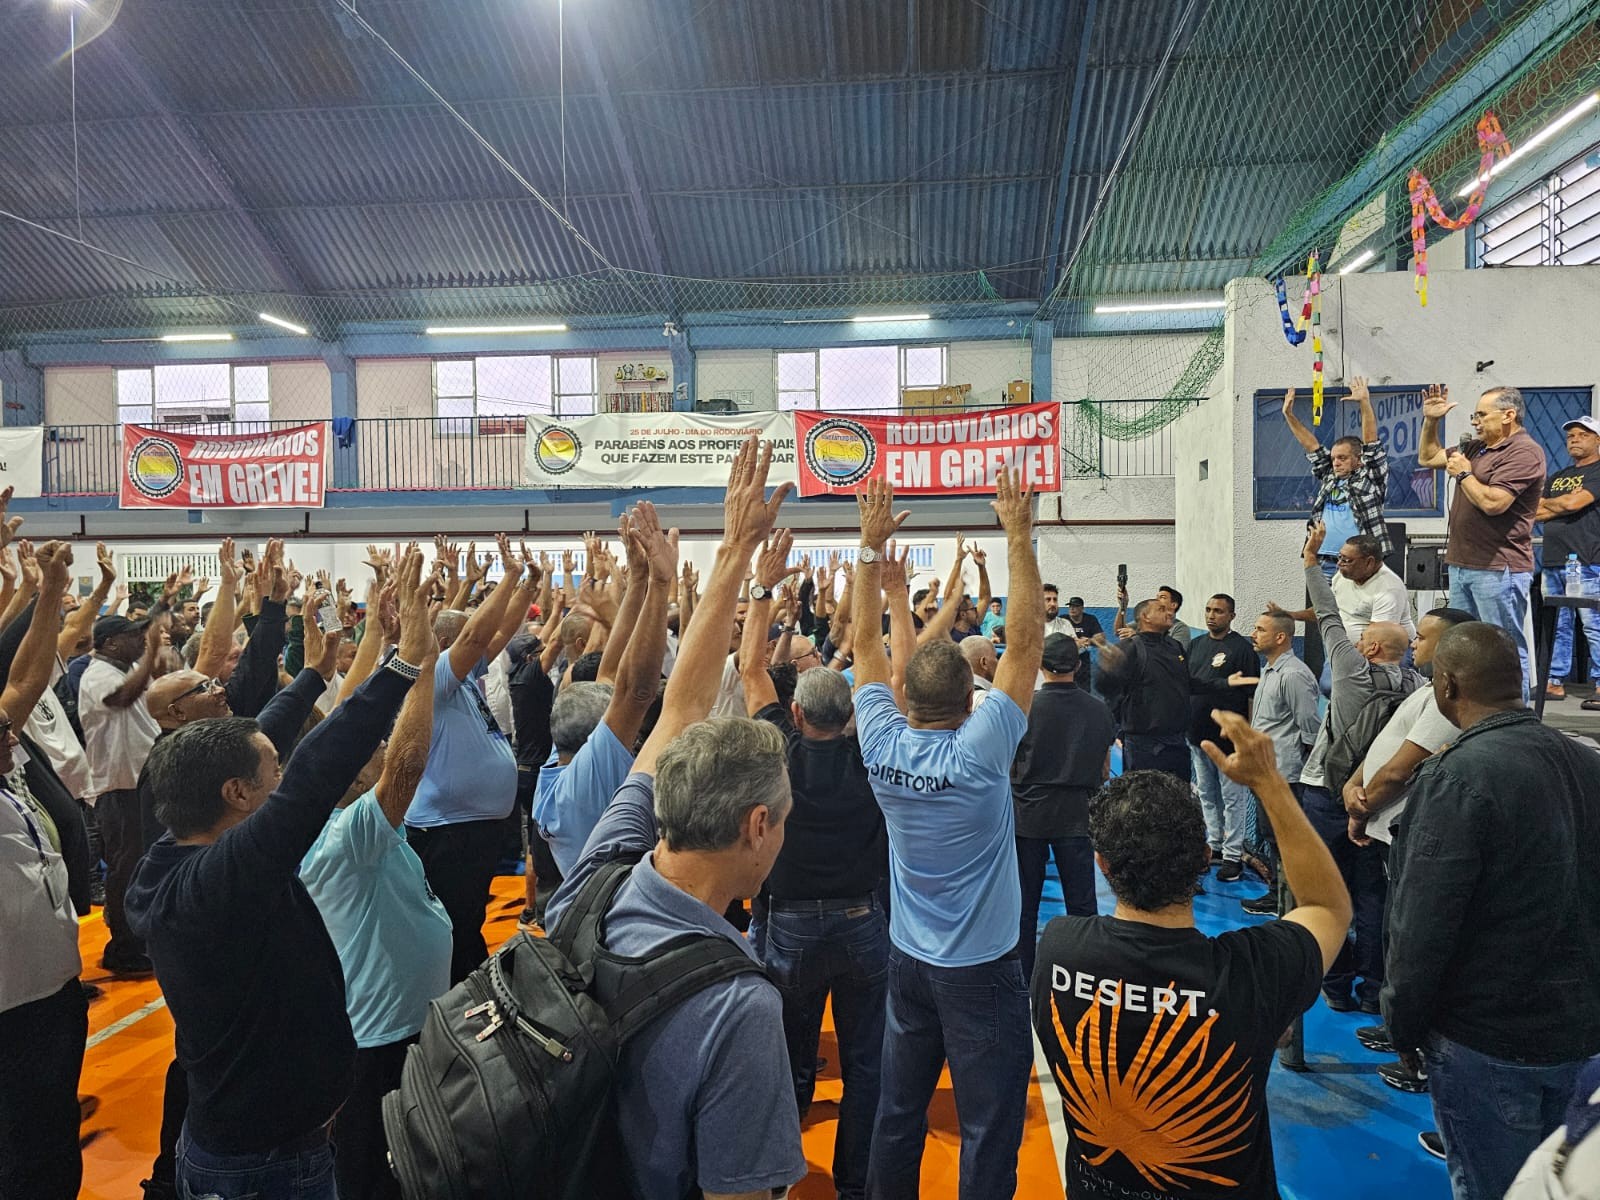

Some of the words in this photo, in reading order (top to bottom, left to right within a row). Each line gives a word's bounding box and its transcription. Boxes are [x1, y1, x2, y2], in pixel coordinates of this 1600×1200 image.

[653, 428, 680, 436] JULHO
[685, 428, 699, 436] DIA
[701, 428, 711, 436] DO
[887, 411, 1053, 445] RODOVIÁRIOS
[188, 429, 318, 458] RODOVIÁRIOS
[594, 437, 666, 450] PARABÉNS
[668, 439, 696, 450] AOS
[600, 453, 630, 465] QUE
[631, 453, 677, 464] FAZEM
[679, 453, 713, 464] ESTE
[886, 450, 931, 487] EM
[940, 445, 1054, 488] GREVE!
[188, 464, 224, 504] EM
[228, 462, 320, 504] GREVE!
[870, 763, 955, 793] DIRETORIA
[1051, 963, 1217, 1018] DESERT.
